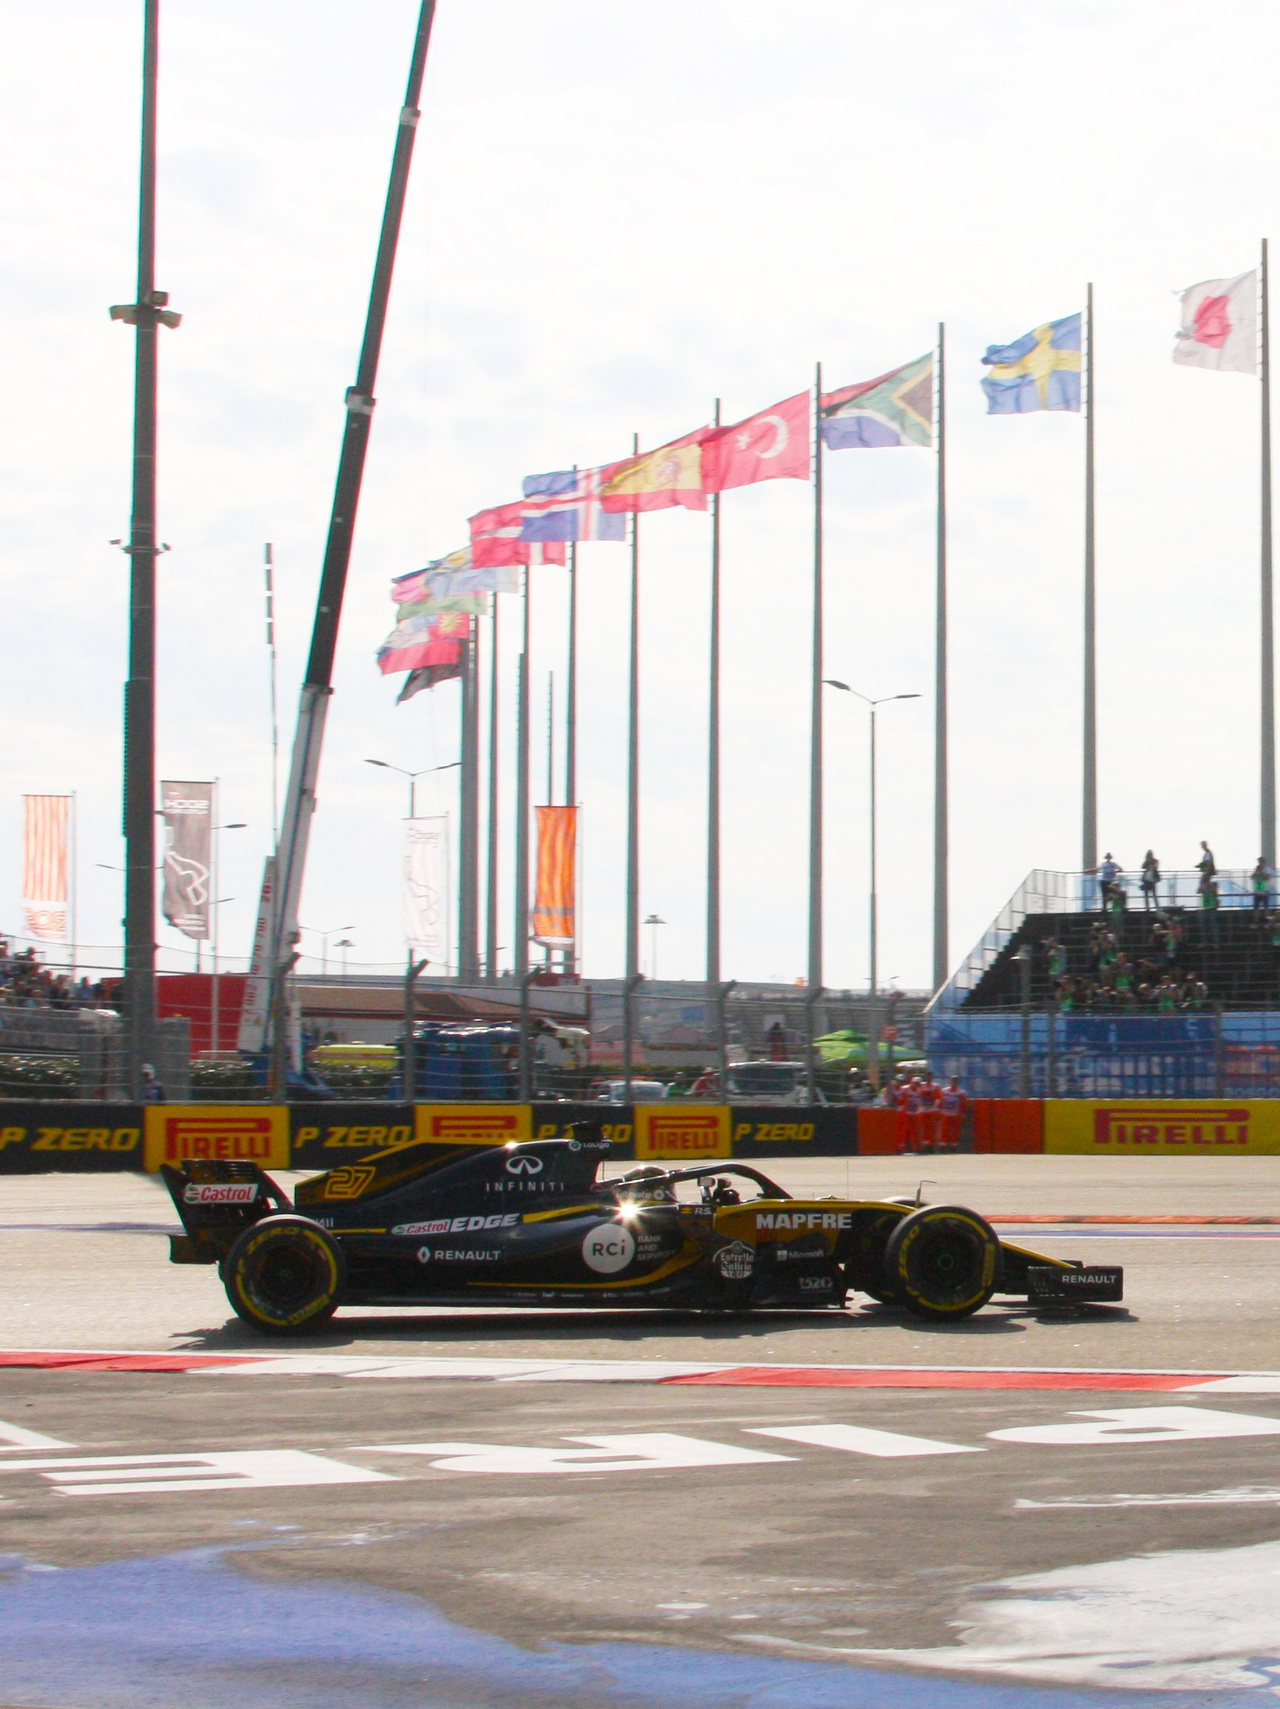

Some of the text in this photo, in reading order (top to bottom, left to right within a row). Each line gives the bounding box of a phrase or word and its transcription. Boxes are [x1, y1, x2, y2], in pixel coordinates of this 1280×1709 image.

[538, 1124, 557, 1139] P
[648, 1116, 719, 1150] PIRELLI
[735, 1124, 815, 1141] P ZERO
[1094, 1108, 1250, 1145] PIRELLI
[0, 1127, 140, 1151] P ZERO
[165, 1117, 271, 1160] PIRELLI
[294, 1127, 319, 1148] P
[323, 1126, 412, 1148] ZERO
[325, 1166, 376, 1199] 27
[486, 1182, 564, 1192] INFINITI
[201, 1187, 252, 1201] Castrol
[406, 1213, 520, 1234] Castrol EDGE
[756, 1213, 852, 1229] MAPFRE
[592, 1239, 626, 1256] RCi
[637, 1235, 662, 1243] BANK
[435, 1250, 502, 1260] RENAULT
[789, 1250, 824, 1259] Microsoft
[1062, 1275, 1117, 1284] RENAULT
